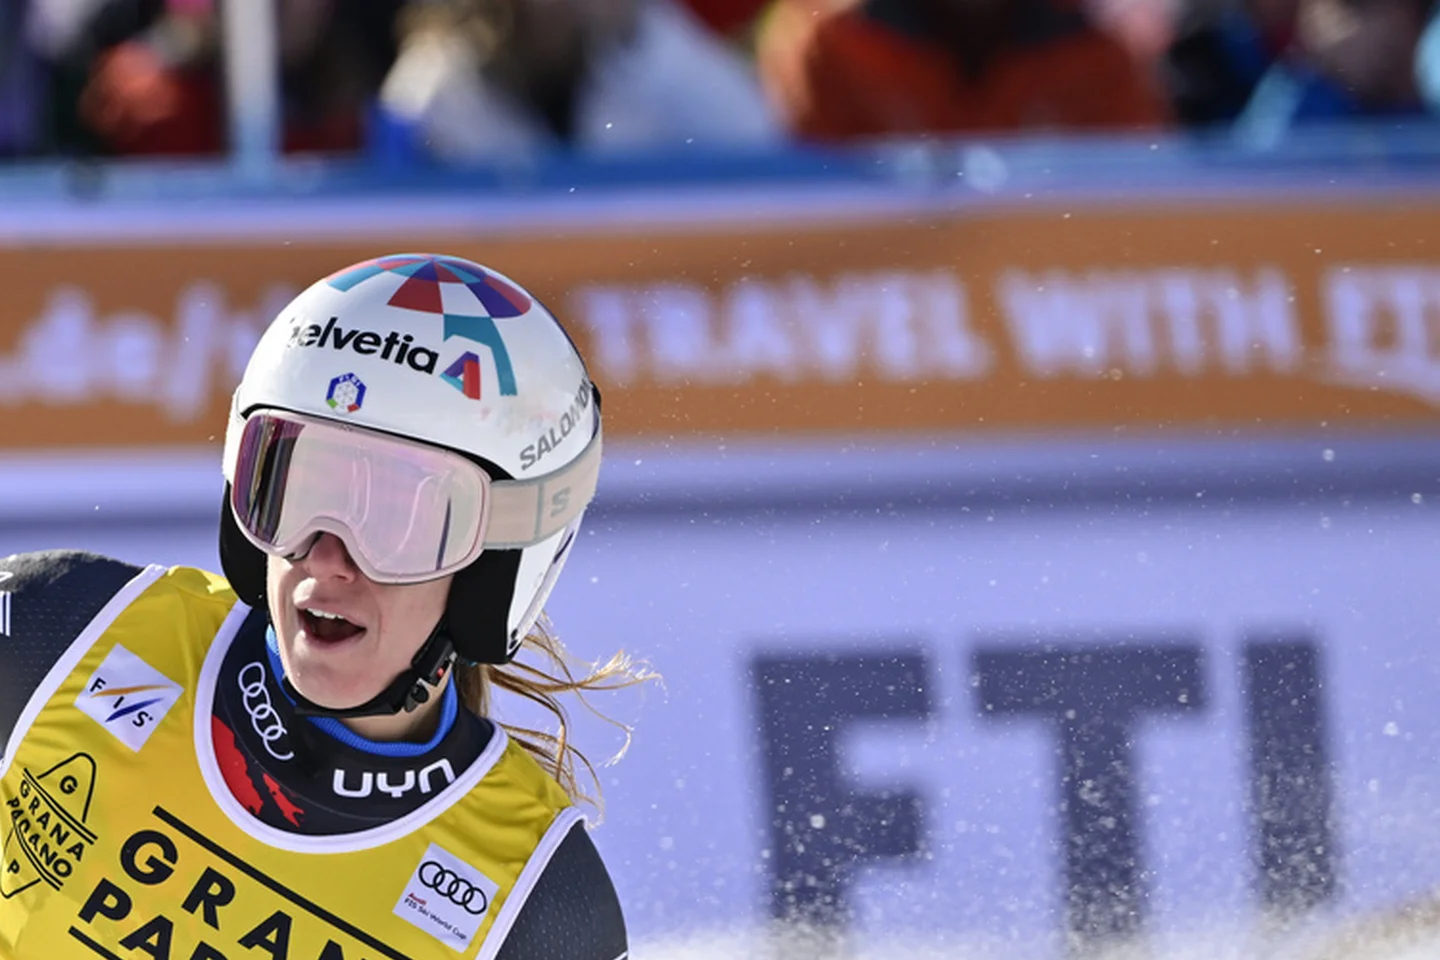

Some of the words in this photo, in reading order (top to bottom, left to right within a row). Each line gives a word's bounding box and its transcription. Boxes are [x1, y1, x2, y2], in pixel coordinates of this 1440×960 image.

[578, 271, 988, 386] TRAVEL
[6, 796, 74, 880] PADANO
[18, 778, 86, 862] GRANA
